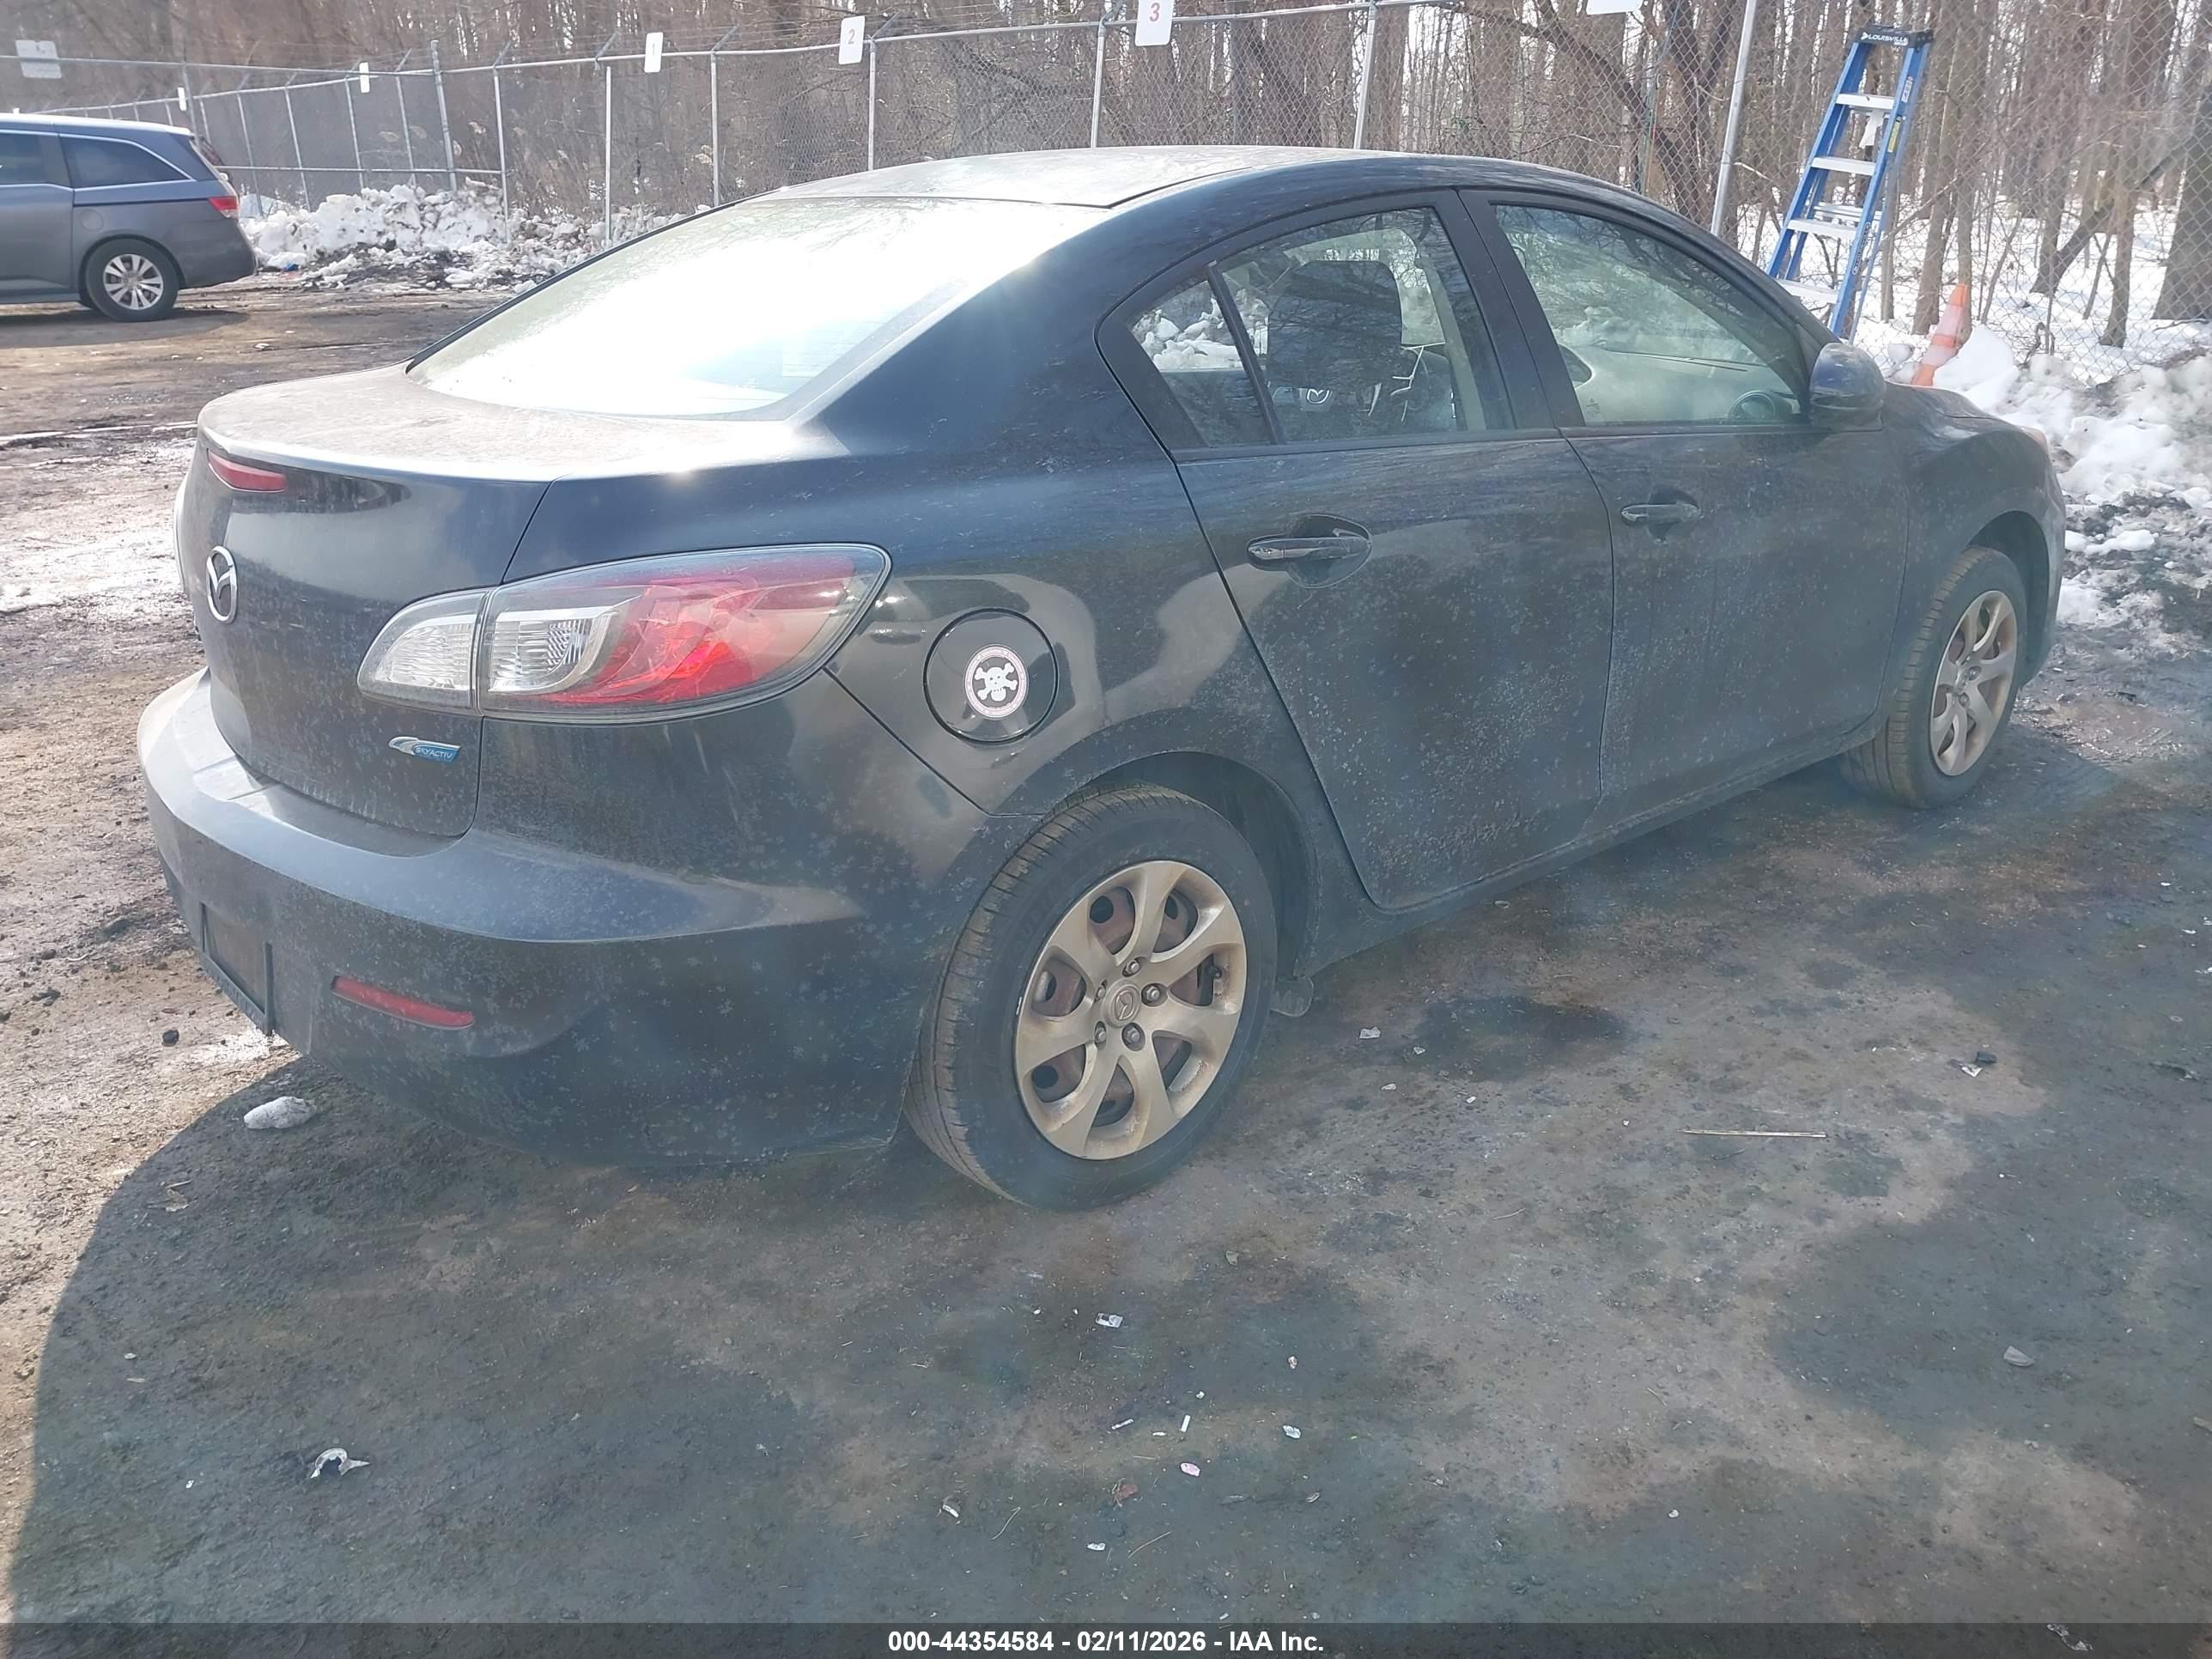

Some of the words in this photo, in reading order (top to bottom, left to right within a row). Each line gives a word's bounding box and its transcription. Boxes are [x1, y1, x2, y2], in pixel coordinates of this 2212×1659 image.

[1149, 2, 1161, 22] 3
[848, 28, 855, 45] 2
[1868, 33, 1908, 43] LOUISVILLE
[415, 747, 453, 759] SKYACTIV
